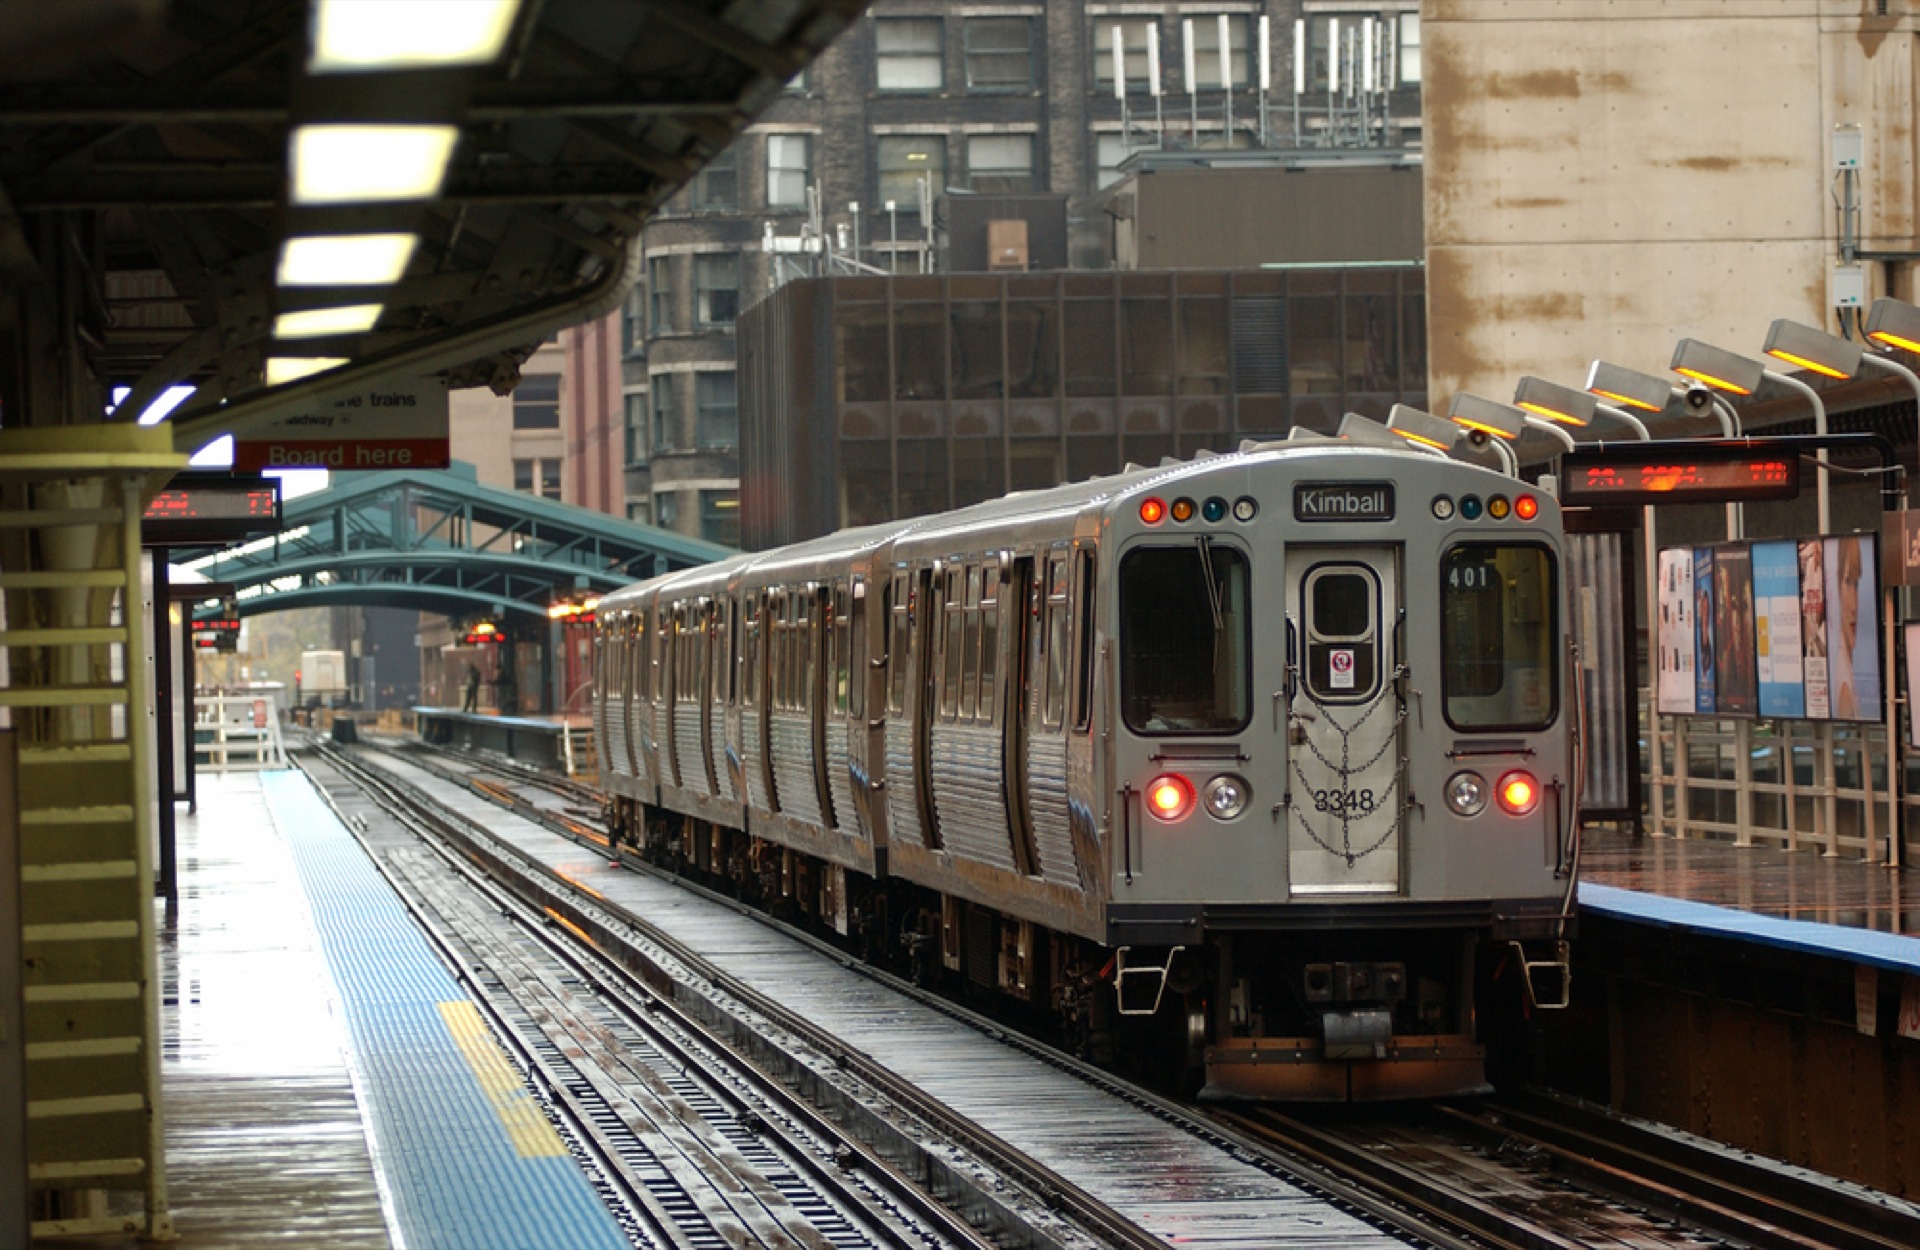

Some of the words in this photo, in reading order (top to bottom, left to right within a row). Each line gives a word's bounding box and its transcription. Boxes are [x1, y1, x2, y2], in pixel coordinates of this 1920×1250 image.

[370, 392, 416, 408] trains
[269, 445, 344, 466] Board
[356, 445, 412, 465] here
[1301, 491, 1385, 513] Kimball
[1449, 566, 1487, 587] 401
